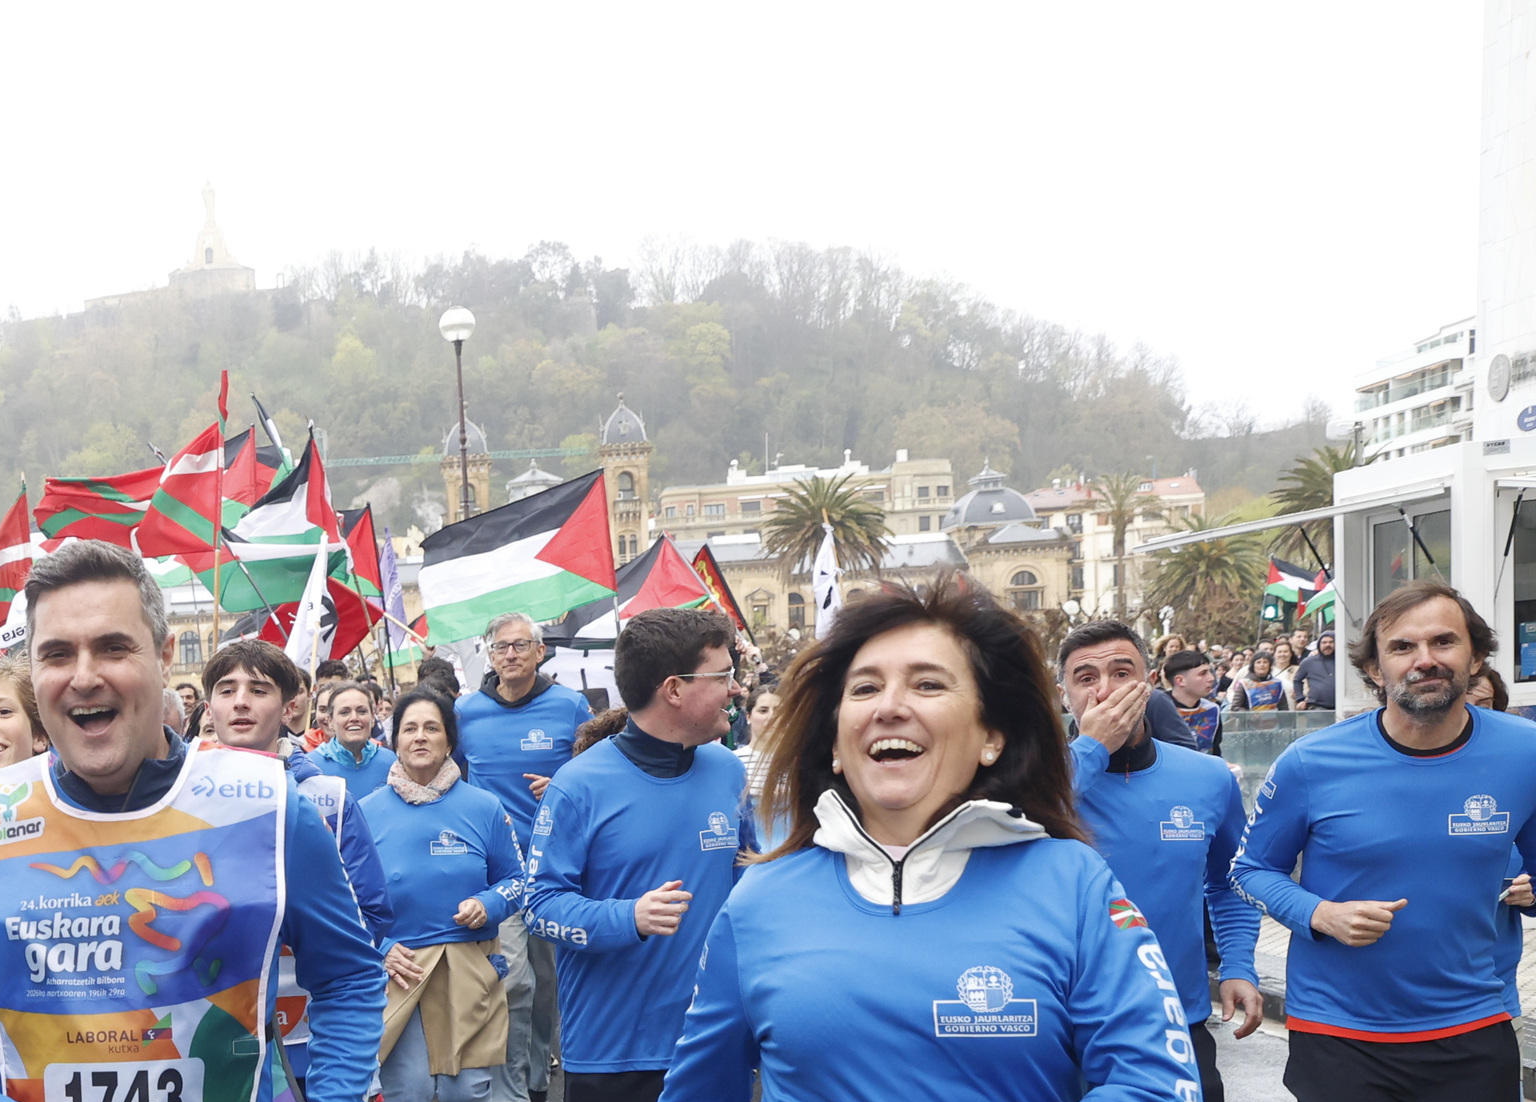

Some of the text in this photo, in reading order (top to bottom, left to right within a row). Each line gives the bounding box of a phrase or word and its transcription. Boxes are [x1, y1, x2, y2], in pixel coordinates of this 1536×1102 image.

[218, 779, 275, 799] eitb
[309, 793, 336, 807] itb
[20, 889, 122, 911] 24.korrika aek
[5, 911, 121, 941] Euskara
[24, 939, 124, 983] gara
[96, 975, 126, 985] Bilbora
[108, 987, 126, 996] 29ra
[939, 1014, 1034, 1025] EUSKO JAURLARITZA
[944, 1024, 1031, 1034] GOBIERNO VASCO
[66, 1029, 139, 1044] LABORAL
[108, 1044, 140, 1054] kutxa
